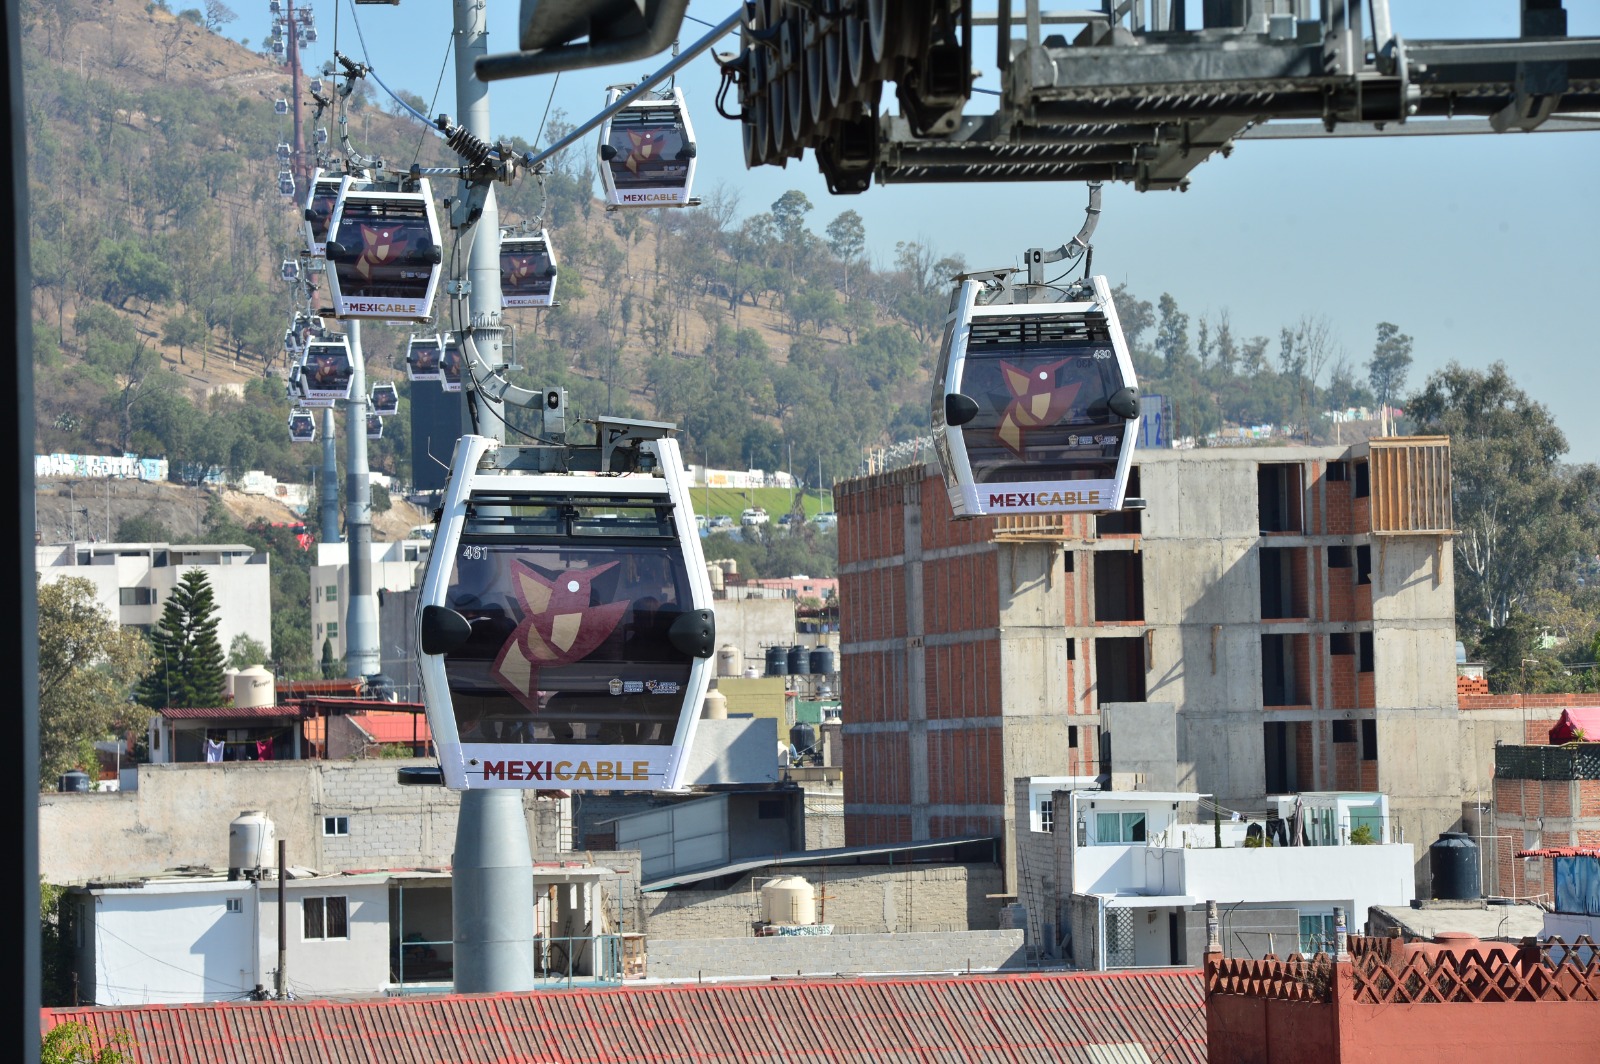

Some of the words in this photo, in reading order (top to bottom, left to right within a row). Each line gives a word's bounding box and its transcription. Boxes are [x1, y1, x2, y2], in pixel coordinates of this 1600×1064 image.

[623, 193, 678, 202] MEXICABLE
[349, 303, 416, 313] MEXICABLE
[1093, 349, 1112, 359] 430
[989, 490, 1100, 508] MEXICABLE
[462, 545, 488, 560] 461
[483, 760, 649, 781] MEXICABLE
